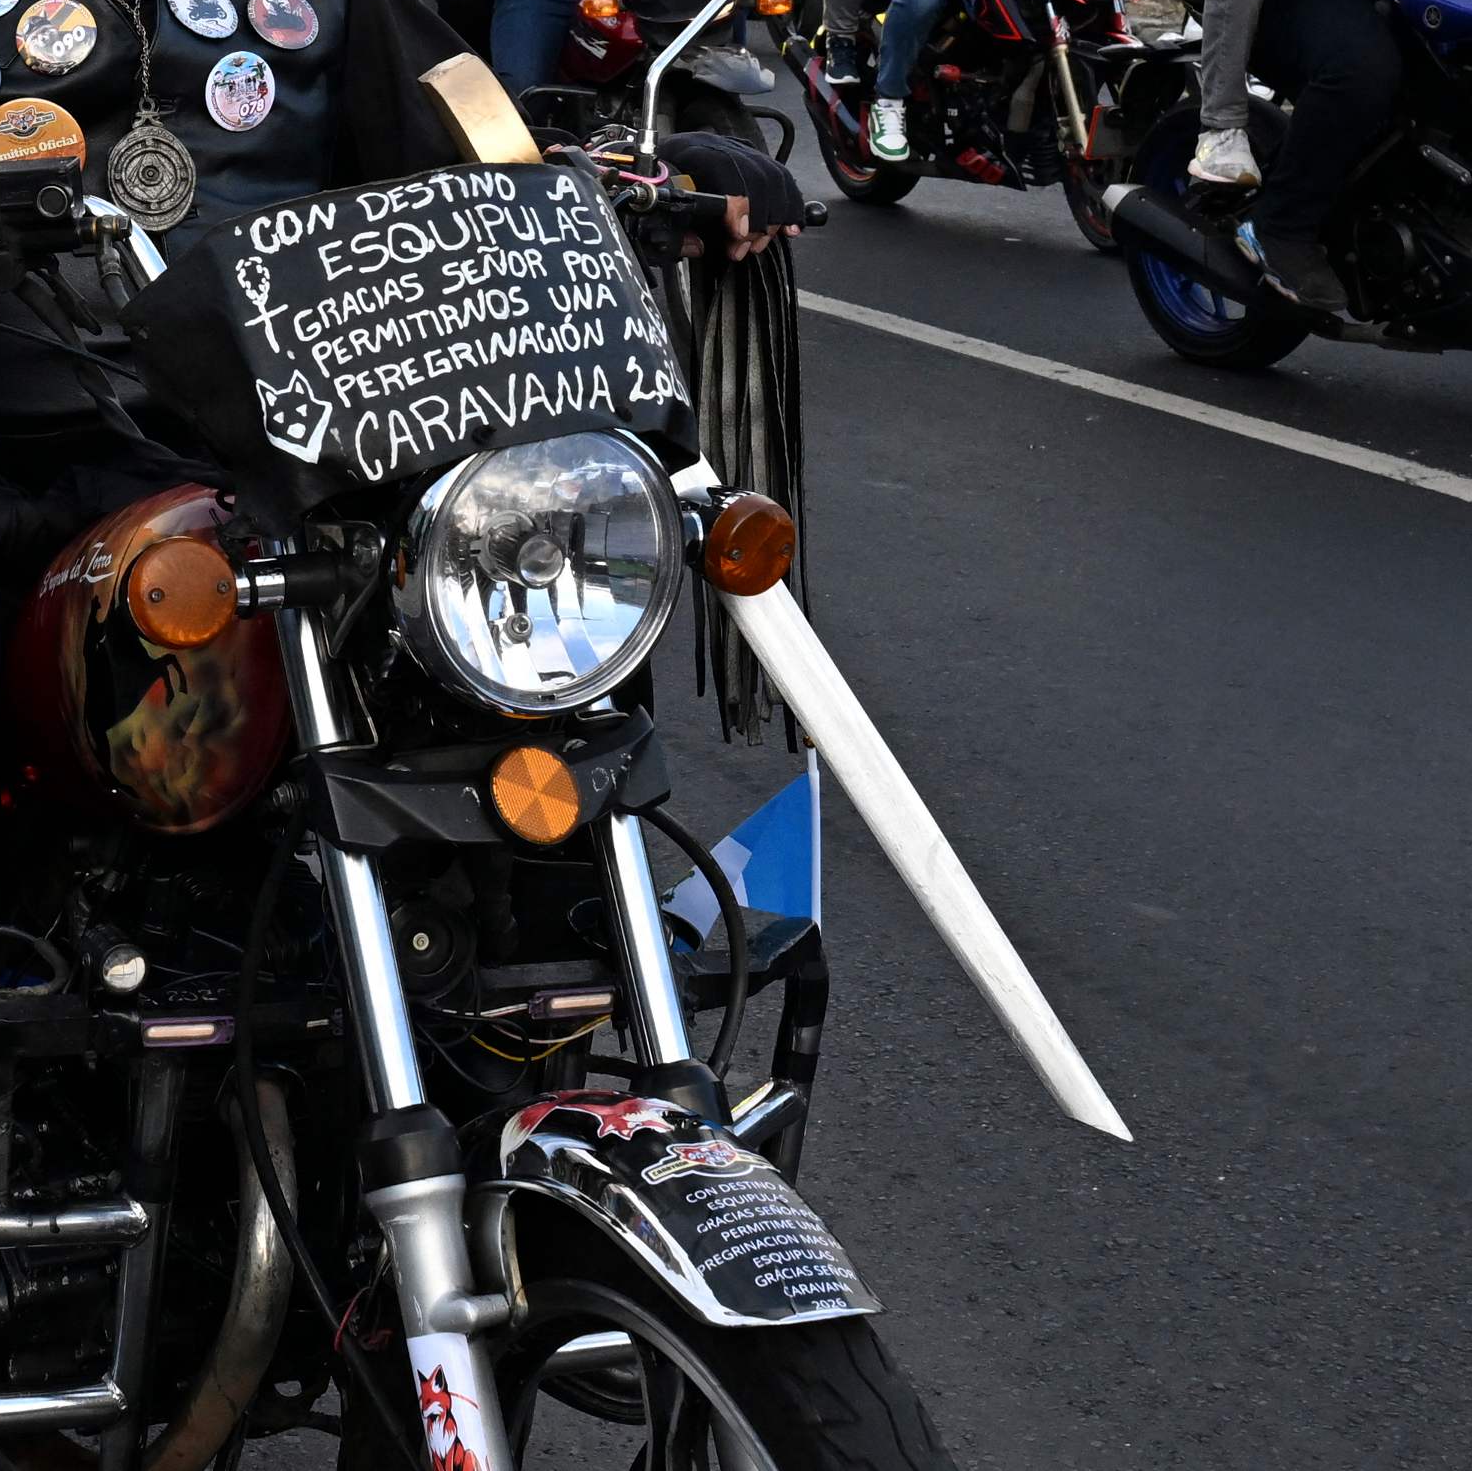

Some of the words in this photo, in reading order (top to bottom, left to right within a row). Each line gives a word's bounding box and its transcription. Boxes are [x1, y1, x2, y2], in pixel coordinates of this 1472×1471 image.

[53, 26, 86, 57] 090
[240, 98, 265, 117] 078
[38, 134, 78, 153] Oficial
[249, 202, 337, 255] CON
[356, 171, 516, 223] DESTINO
[546, 174, 581, 203] A
[316, 202, 603, 282] ESQUIPULAS
[293, 272, 425, 343] GRACIAS
[441, 245, 548, 295] SEÑOR
[563, 250, 624, 283] POR
[311, 285, 530, 378] PERMITIRNOS
[548, 282, 618, 314] UNA
[333, 314, 606, 408] PEREGRINACIÓN
[353, 364, 616, 483] CARAVANA
[69, 555, 86, 580] del
[79, 542, 116, 583] Zorro
[685, 1186, 718, 1204] CON
[718, 1180, 776, 1194] DESTINO
[779, 1182, 789, 1193] A
[707, 1192, 789, 1211] ESQUIPULAS
[696, 1208, 755, 1234] GRACIAS
[721, 1219, 796, 1242] PERMITIME
[796, 1221, 826, 1234] UNA
[697, 1234, 799, 1278] PREGRINACION
[799, 1234, 829, 1247] MAS
[752, 1248, 839, 1269] ESQUIPULAS.
[754, 1265, 814, 1288] GRACIAS
[814, 1263, 857, 1281] SEÑOR
[783, 1280, 855, 1298] CARAVANA
[811, 1297, 847, 1311] 2026
